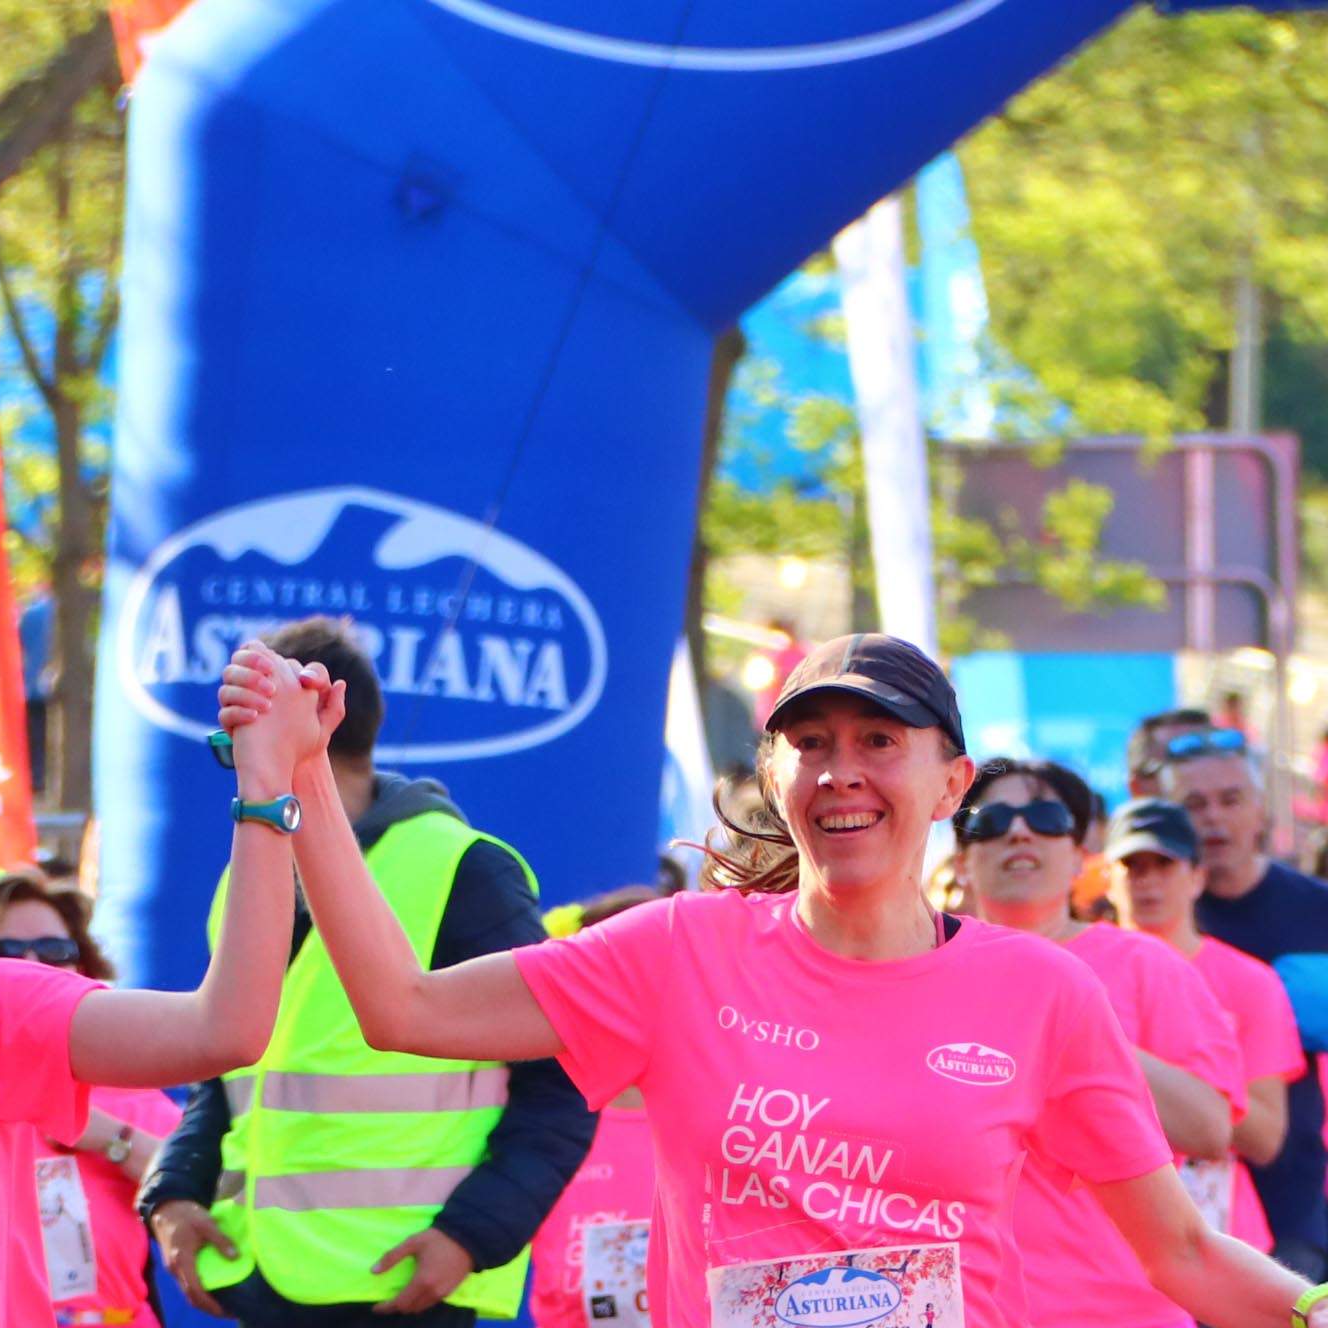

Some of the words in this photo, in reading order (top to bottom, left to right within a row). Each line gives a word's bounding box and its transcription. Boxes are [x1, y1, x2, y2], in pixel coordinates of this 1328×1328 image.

[200, 576, 371, 609] CENTRAL
[386, 586, 564, 629] LECHERA
[718, 1005, 820, 1051] OYSHO
[934, 1053, 1010, 1078] ASTURIANA
[727, 1082, 831, 1131] HOY
[721, 1124, 893, 1185] GANAN
[721, 1167, 791, 1209] LAS
[802, 1181, 967, 1239] CHICAS
[784, 1292, 893, 1317] ASTURIANA
